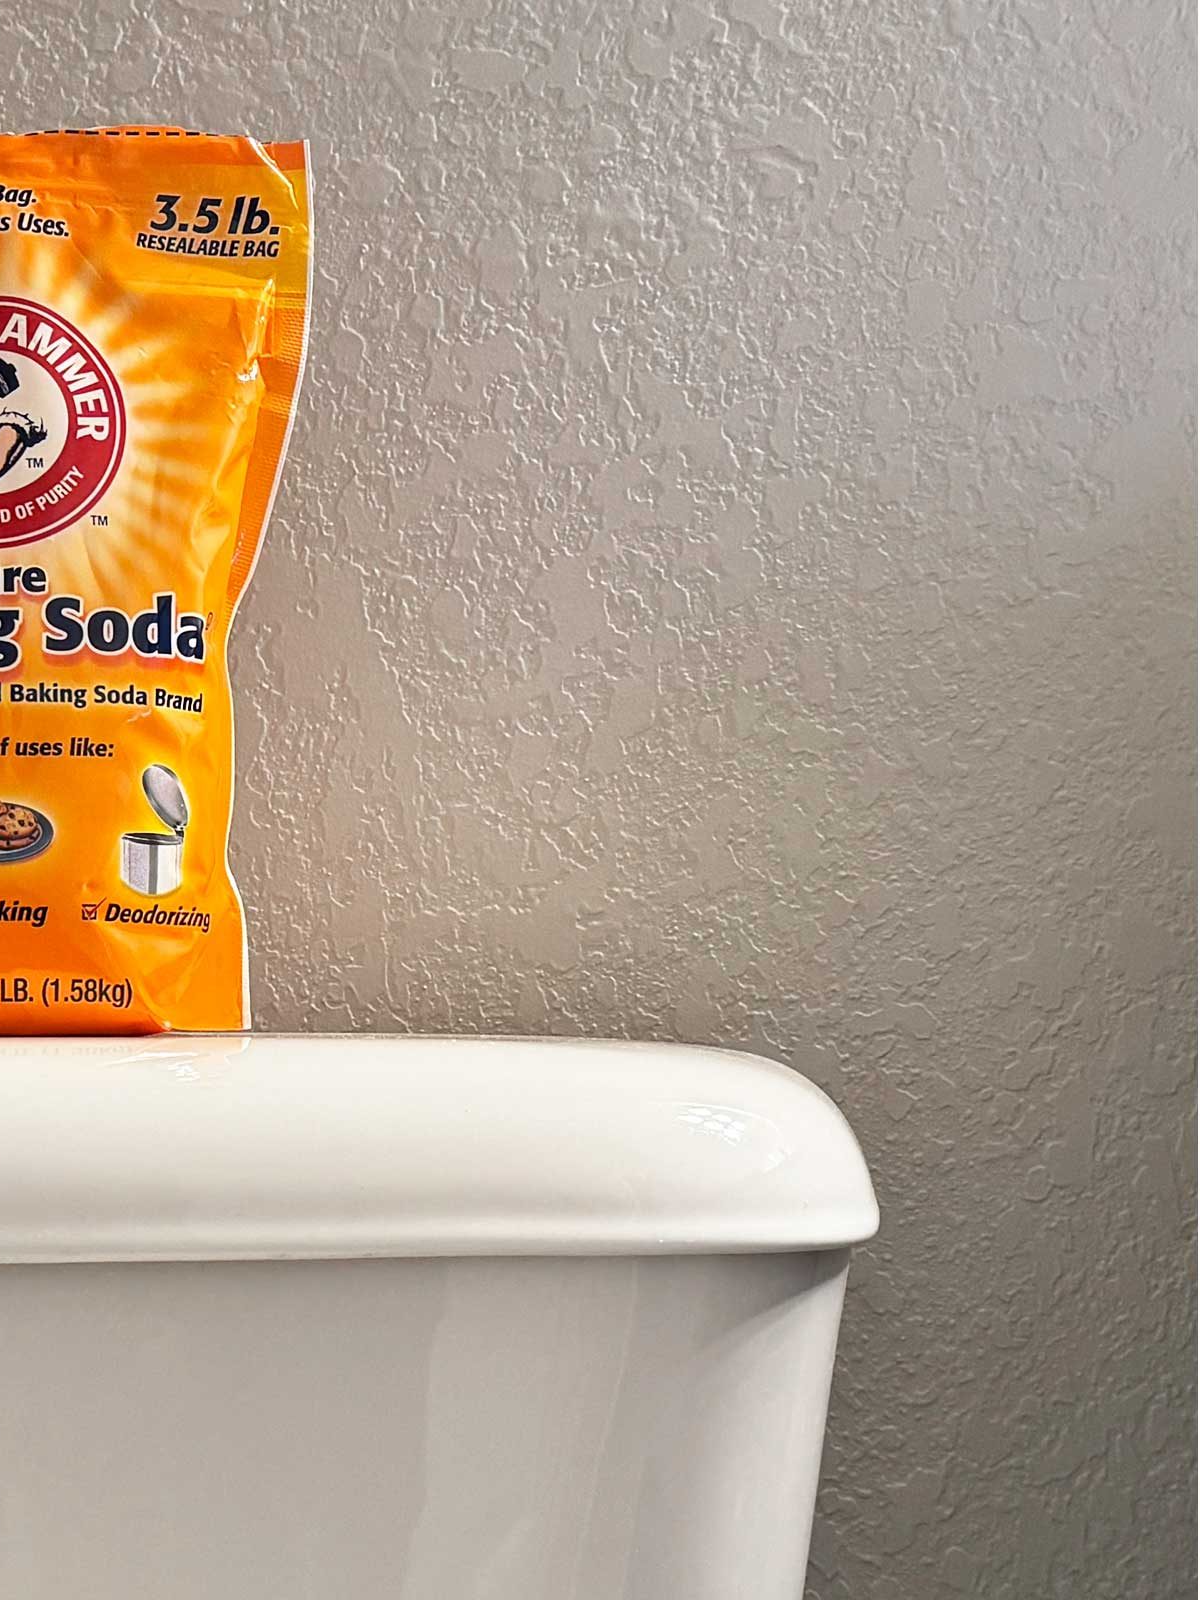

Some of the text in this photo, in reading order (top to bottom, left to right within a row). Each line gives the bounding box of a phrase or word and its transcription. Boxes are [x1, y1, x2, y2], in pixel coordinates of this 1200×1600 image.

[17, 214, 70, 237] Uses.
[149, 194, 281, 235] 3.5 lb.
[136, 233, 280, 258] RESEALABLE BAG
[25, 458, 44, 469] TM
[15, 503, 35, 520] OF
[38, 465, 85, 512] PURITY
[90, 515, 109, 526] TM
[44, 594, 205, 661] Soda
[10, 682, 87, 709] Baking
[94, 684, 148, 706] Soda
[155, 688, 203, 713] Brand
[15, 740, 63, 757] uses
[69, 737, 114, 757] like:
[104, 903, 211, 933] Deodorizing
[0, 978, 34, 1004] LB.
[41, 977, 133, 1008] (1.58kg)
